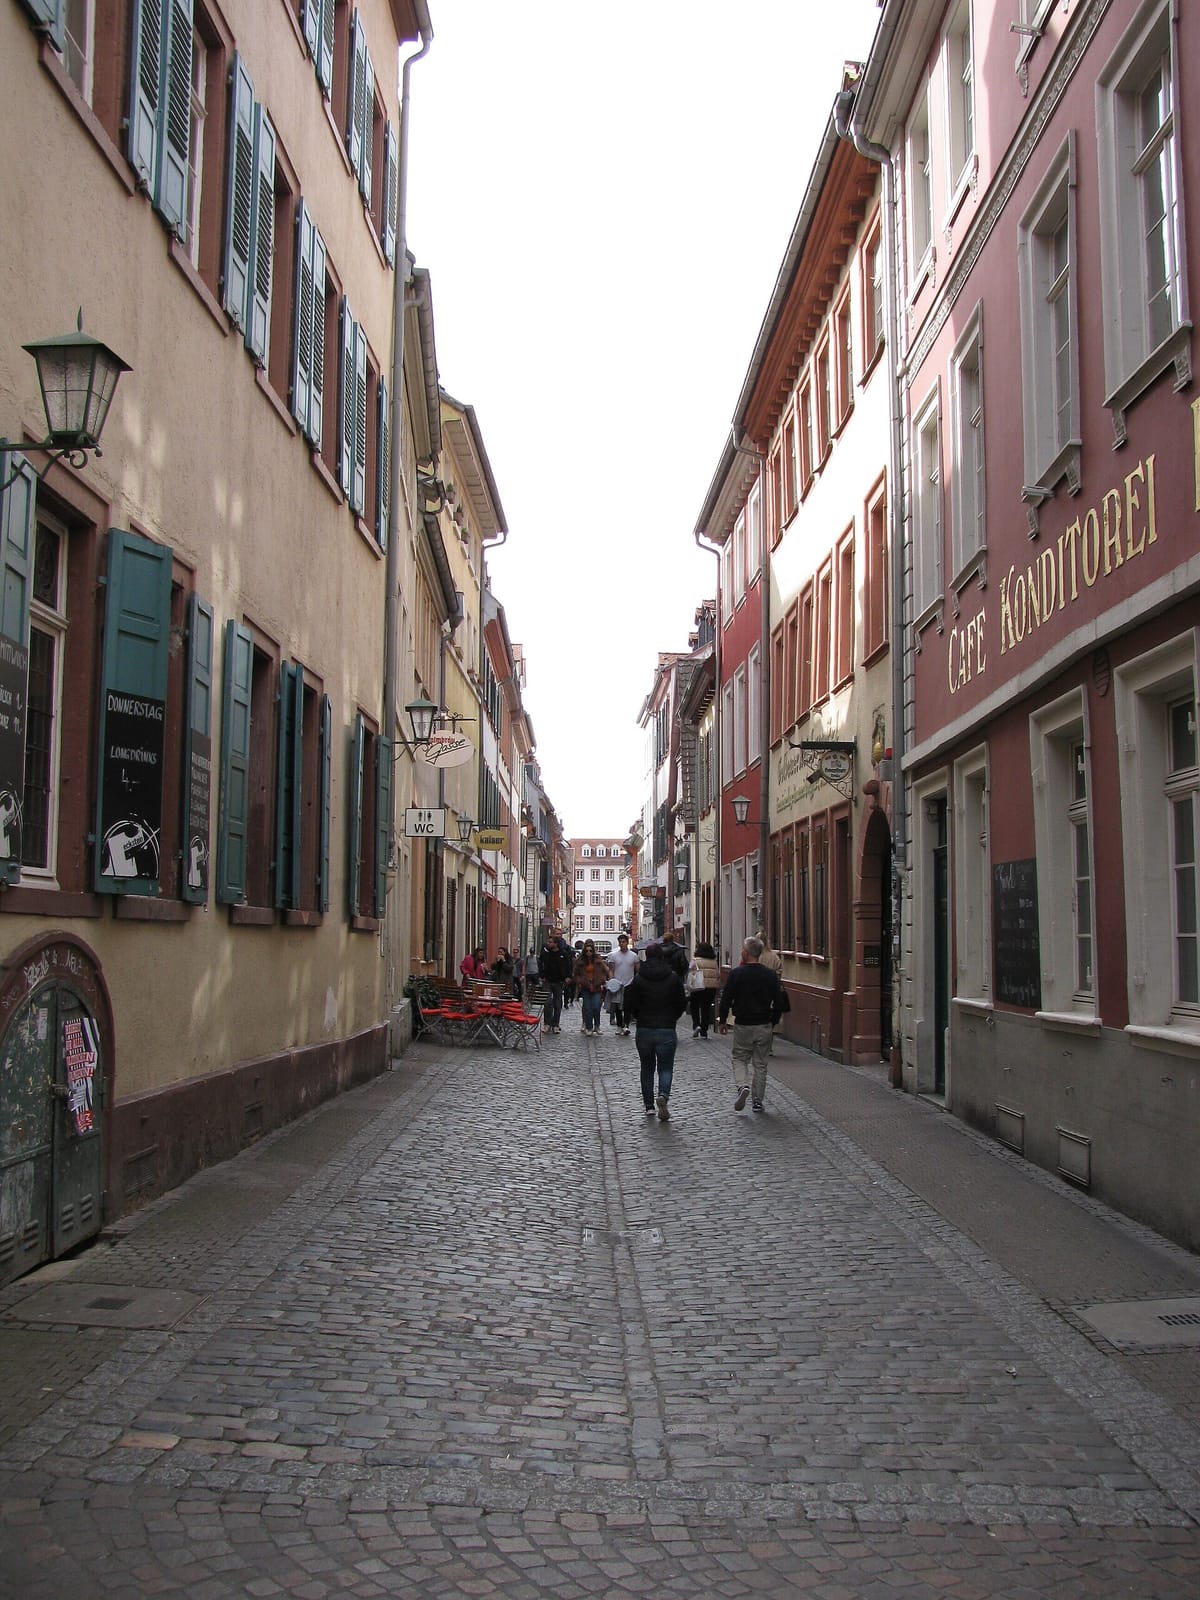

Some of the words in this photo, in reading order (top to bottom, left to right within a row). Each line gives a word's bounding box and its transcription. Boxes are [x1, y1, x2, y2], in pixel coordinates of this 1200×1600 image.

[999, 453, 1158, 656] KONDITOREI
[107, 694, 163, 721] DONNERSTAG
[425, 738, 466, 765] Gasse
[414, 823, 434, 834] WC
